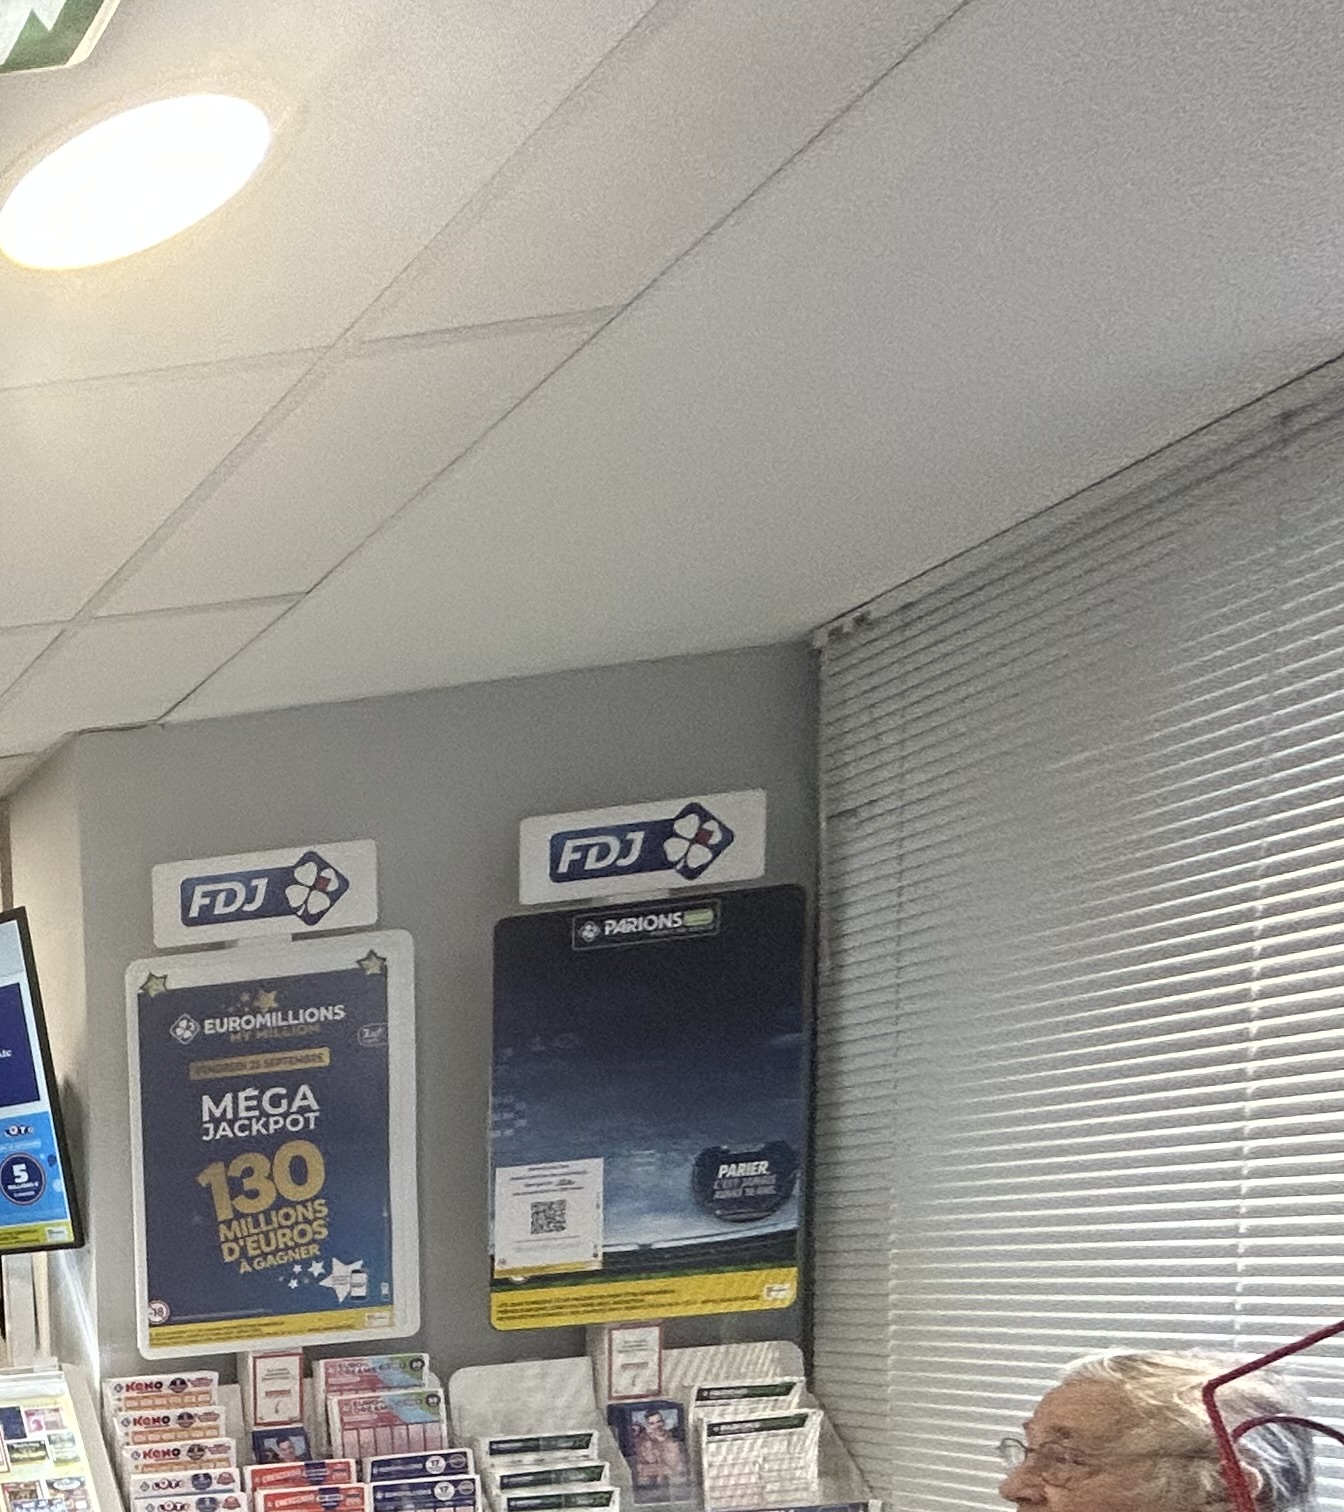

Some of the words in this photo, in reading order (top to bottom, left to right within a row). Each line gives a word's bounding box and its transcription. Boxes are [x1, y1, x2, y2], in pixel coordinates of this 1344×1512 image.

[557, 831, 645, 874] FDJ
[188, 876, 269, 918] FDJ
[604, 911, 683, 935] PARIONS
[204, 1004, 346, 1035] EUROMILLIONS
[201, 1084, 320, 1122] MÉGA
[201, 1111, 321, 1141] JACKPOT
[12, 1163, 28, 1183] 5
[195, 1139, 326, 1222] 130
[218, 1198, 329, 1242] MILLIONS
[219, 1219, 329, 1263] D'EUROS
[253, 1243, 321, 1270] GAGNER
